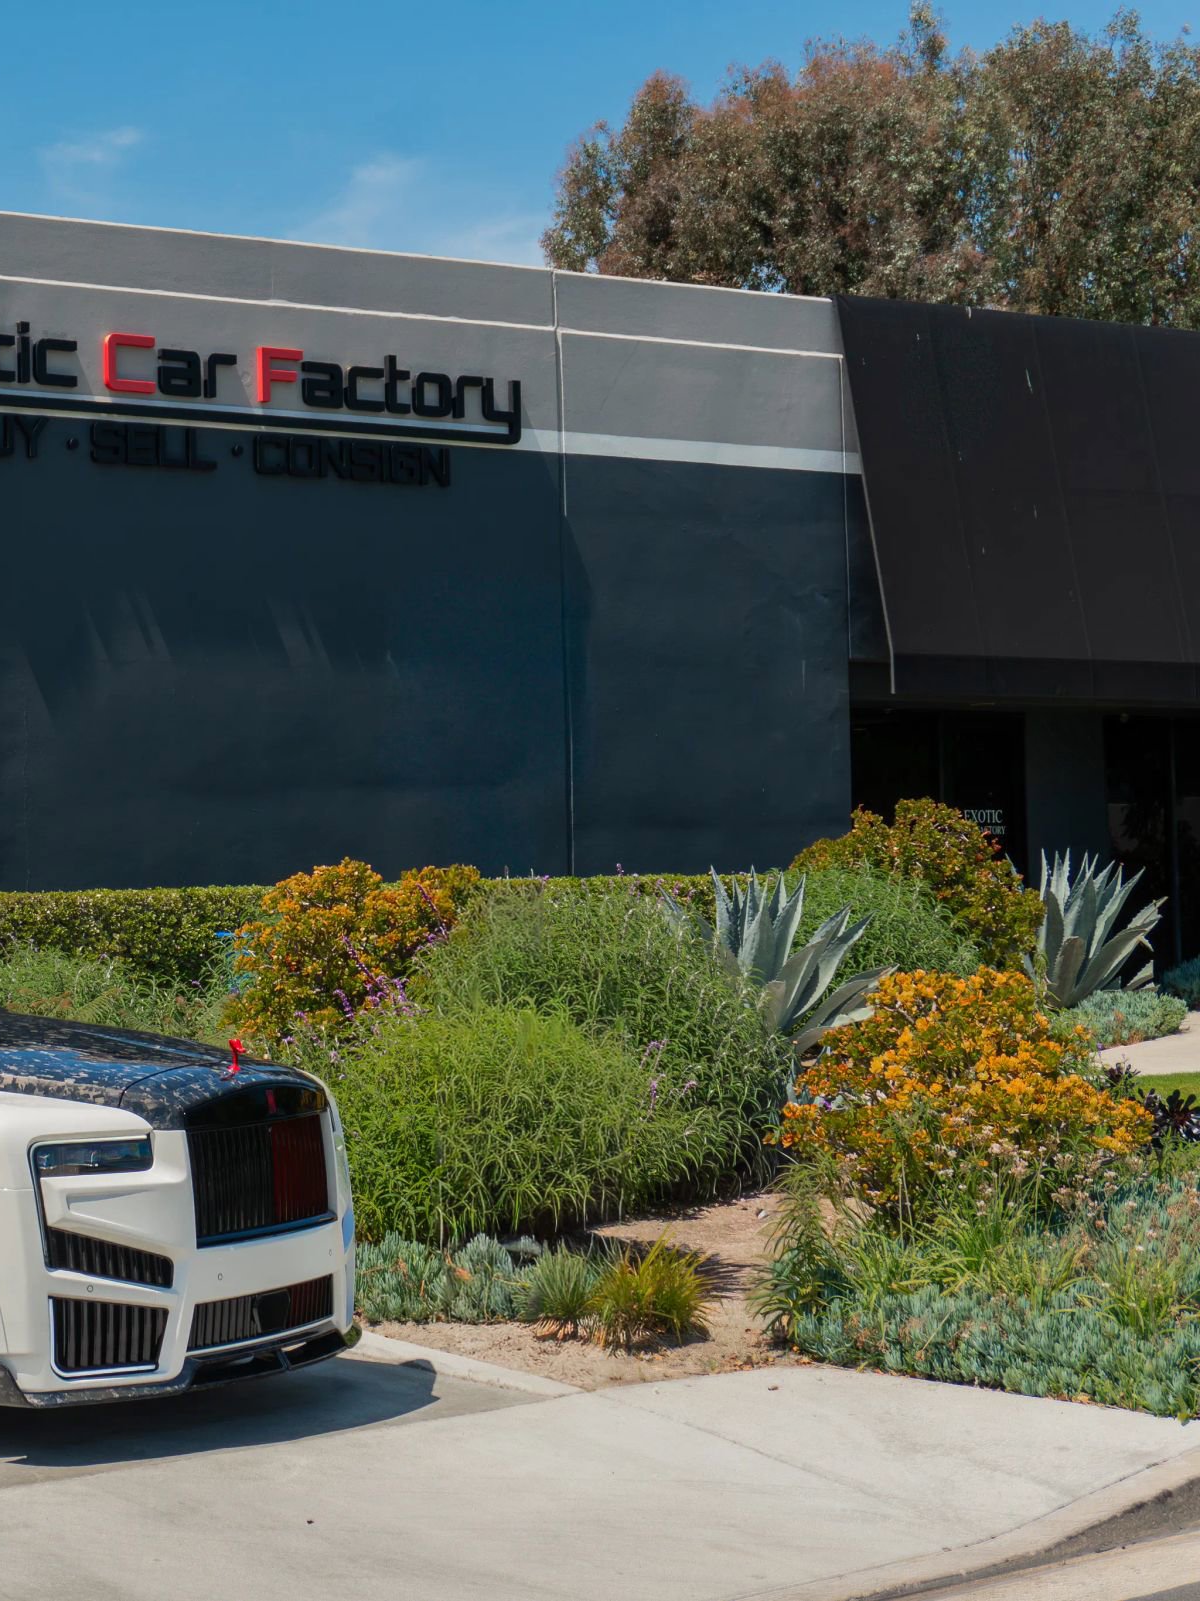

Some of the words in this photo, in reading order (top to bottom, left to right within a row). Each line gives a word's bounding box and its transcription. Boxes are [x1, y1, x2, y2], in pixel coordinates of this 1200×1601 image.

[103, 333, 238, 398] Car
[256, 346, 522, 444] Factory
[89, 424, 218, 471] SELL
[253, 436, 451, 488] CONSIGN
[964, 809, 1003, 823] EXOTIC
